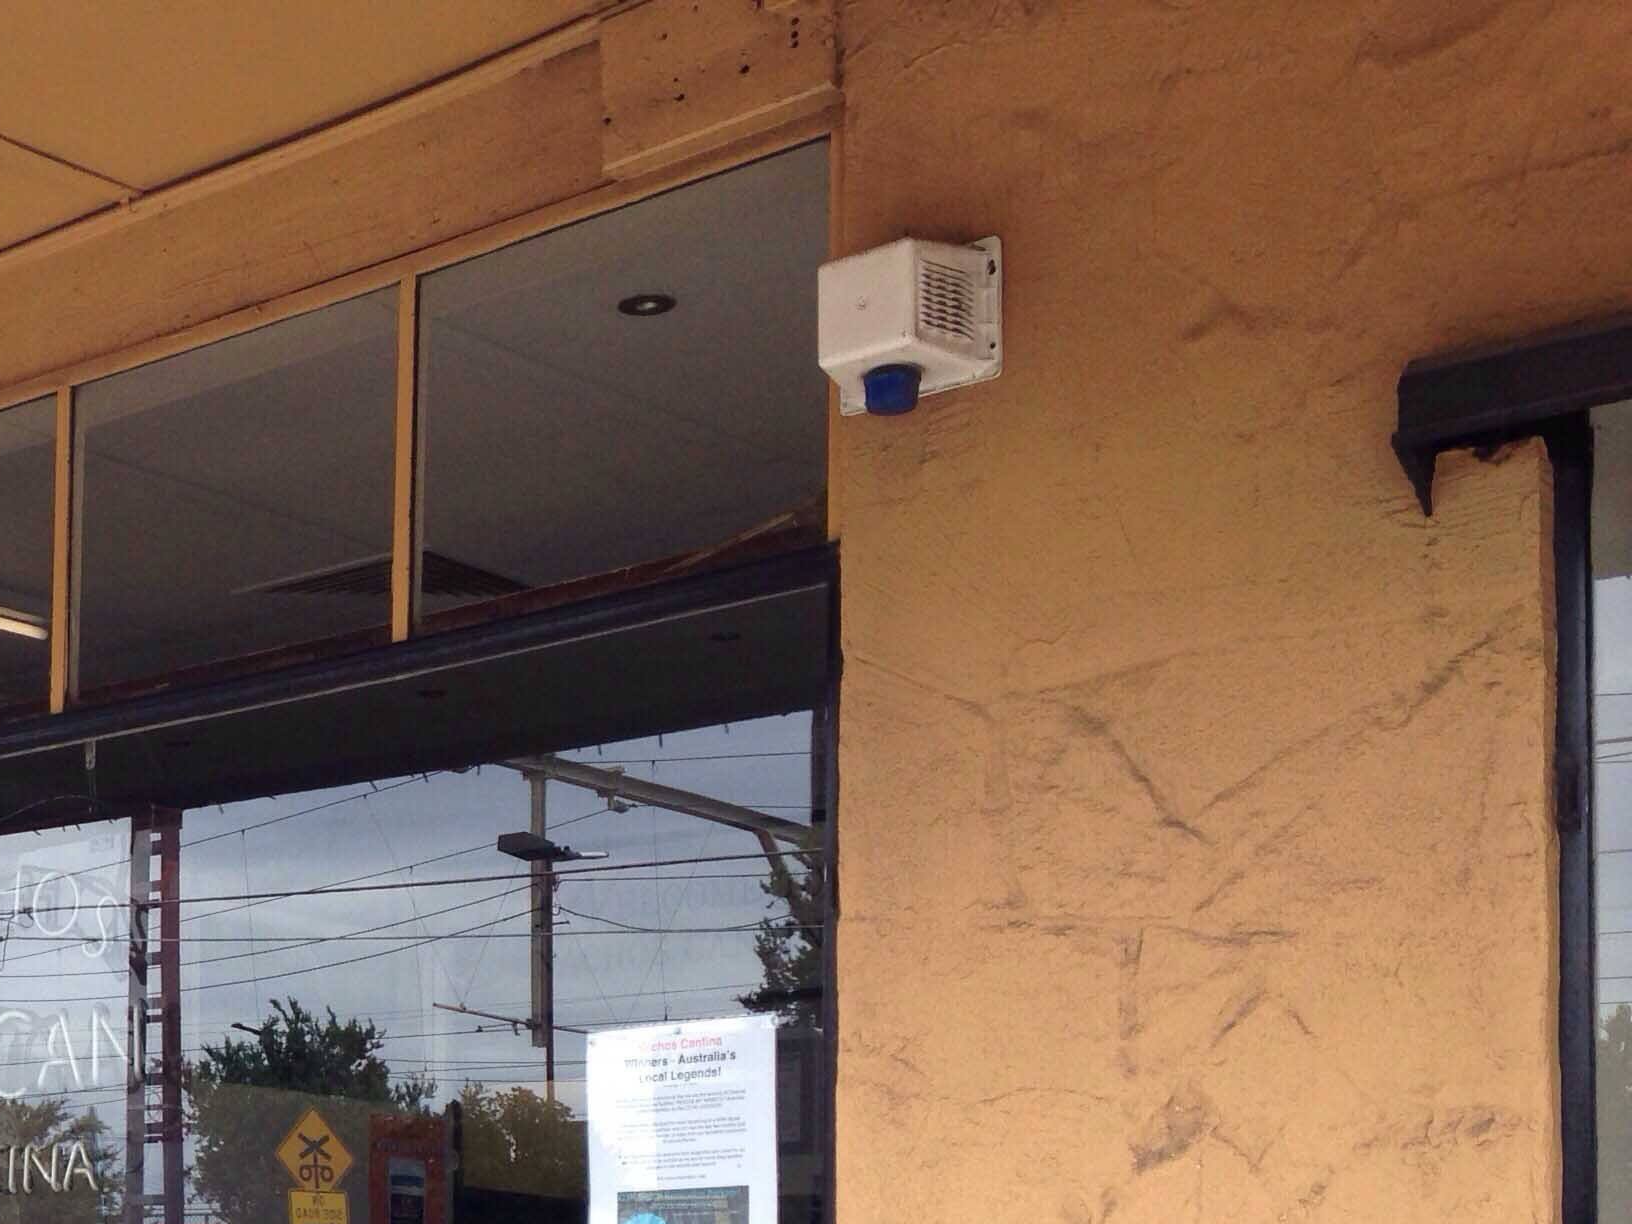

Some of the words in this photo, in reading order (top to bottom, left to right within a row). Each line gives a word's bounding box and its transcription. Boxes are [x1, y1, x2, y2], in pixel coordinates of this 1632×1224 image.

[680, 1036, 723, 1049] Cantina
[678, 1050, 737, 1065] Australia's
[671, 1066, 722, 1083] Legends!
